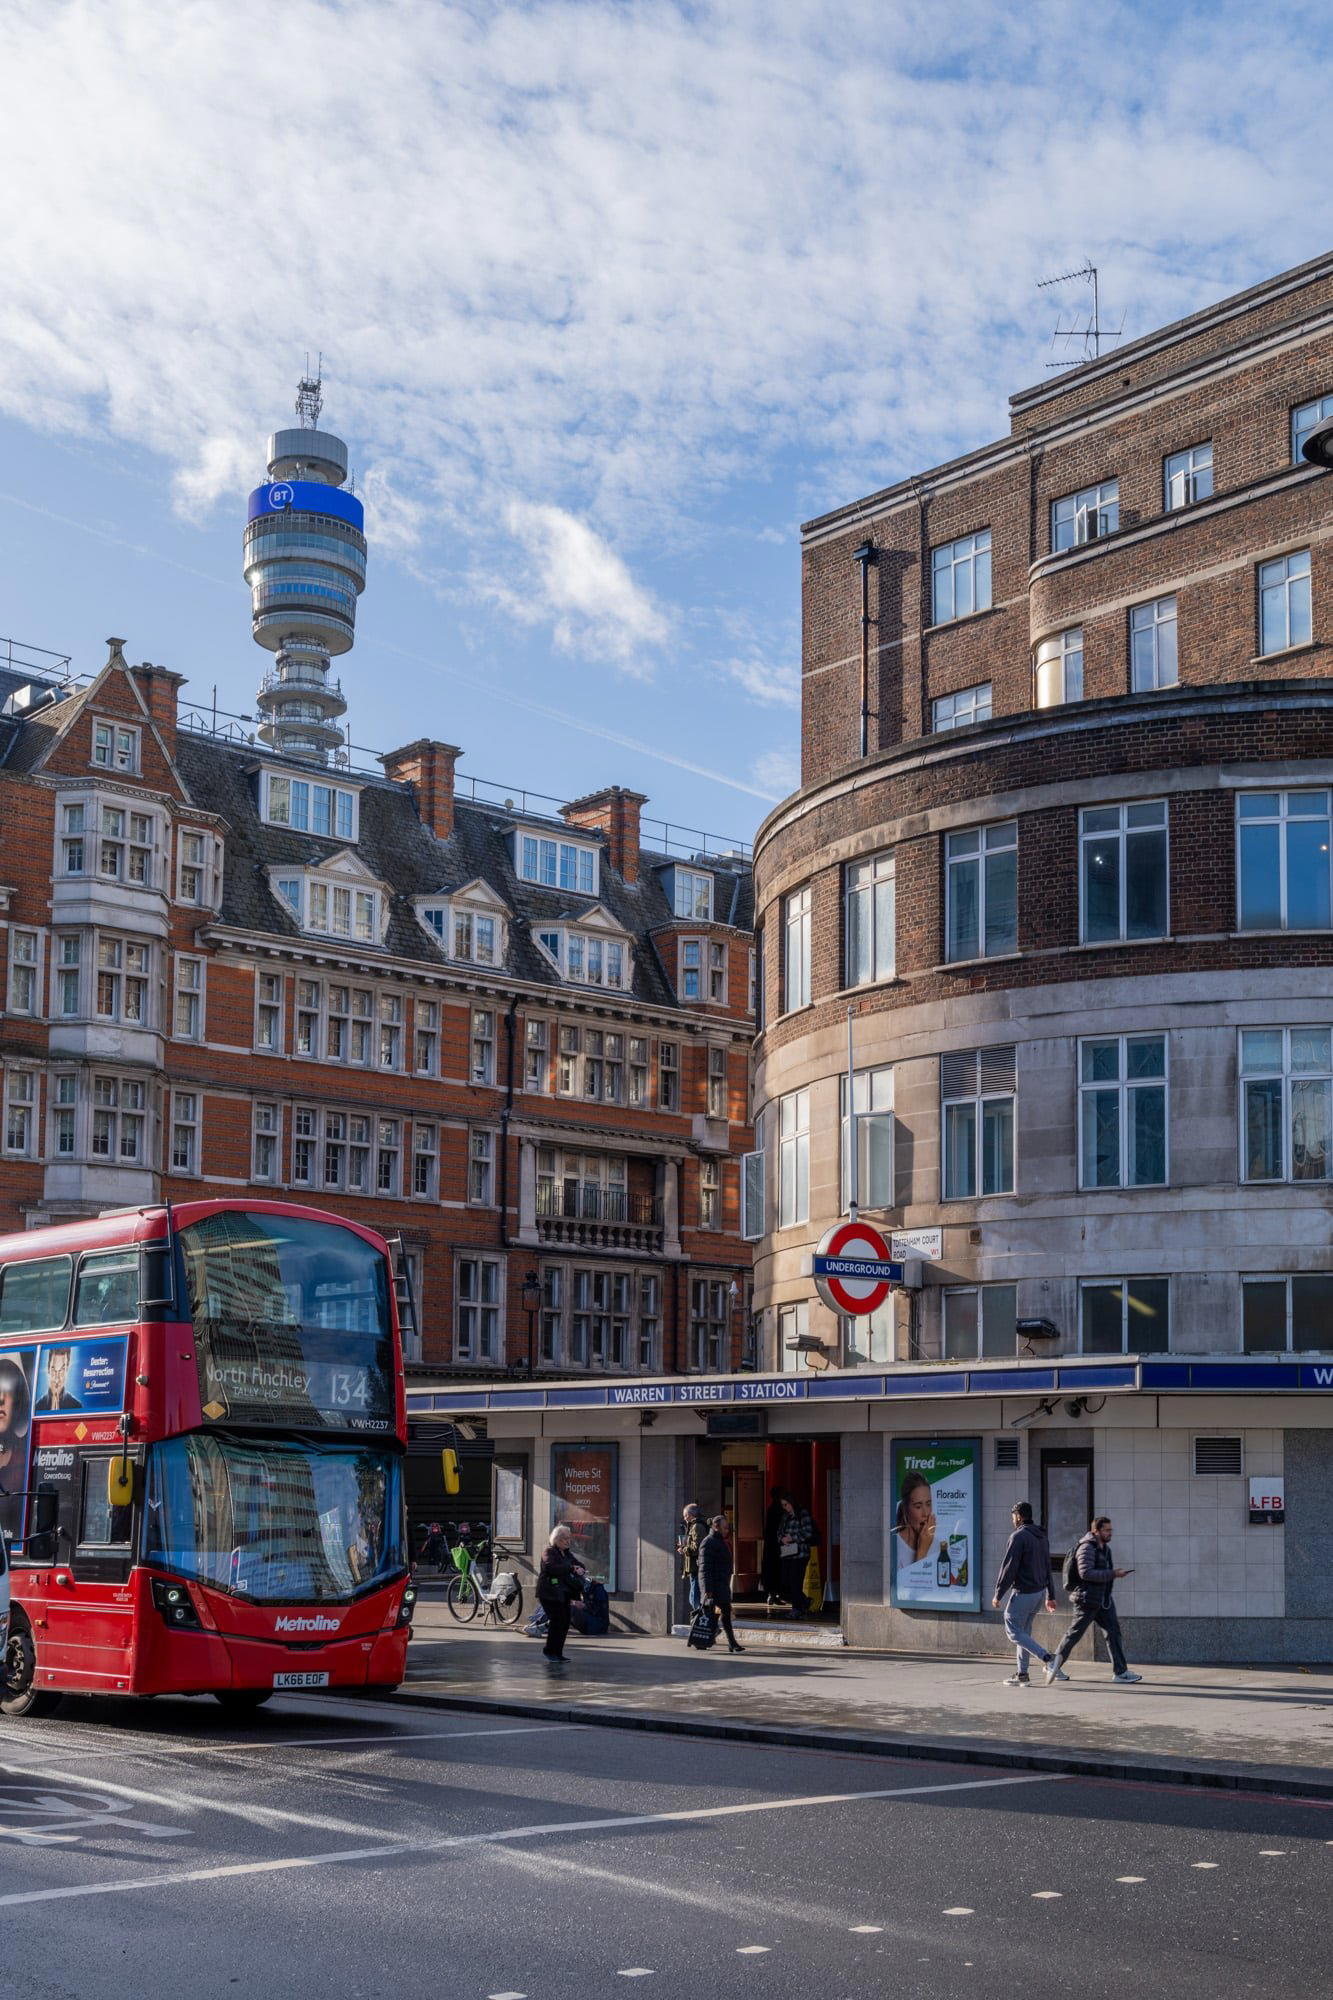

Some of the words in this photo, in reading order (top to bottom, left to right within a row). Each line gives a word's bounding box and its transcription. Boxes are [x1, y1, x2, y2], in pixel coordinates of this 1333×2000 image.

[274, 491, 288, 501] BT
[893, 1236, 921, 1248] TOTTENHAM
[922, 1234, 939, 1245] COURT
[893, 1250, 906, 1259] ROAD
[826, 1261, 890, 1276] UNDERGROUND
[83, 1367, 114, 1377] Resurrection
[206, 1364, 247, 1385] North
[252, 1369, 311, 1394] Finchley
[232, 1386, 259, 1398] TALLY
[331, 1371, 368, 1407] 134
[614, 1387, 665, 1403] WARREN
[680, 1385, 724, 1400] STREET
[741, 1383, 797, 1398] STATION
[352, 1418, 389, 1430] VWH2237
[92, 1431, 115, 1440] VWH2237
[33, 1449, 74, 1467] Metroline
[904, 1456, 936, 1470] Tired
[565, 1468, 590, 1478] Where
[591, 1468, 601, 1478] Sit
[566, 1483, 600, 1493] Happens
[1250, 1497, 1282, 1509] LFB
[275, 1615, 340, 1632] Metroline
[277, 1674, 303, 1686] LK66
[306, 1673, 325, 1685] EOF
